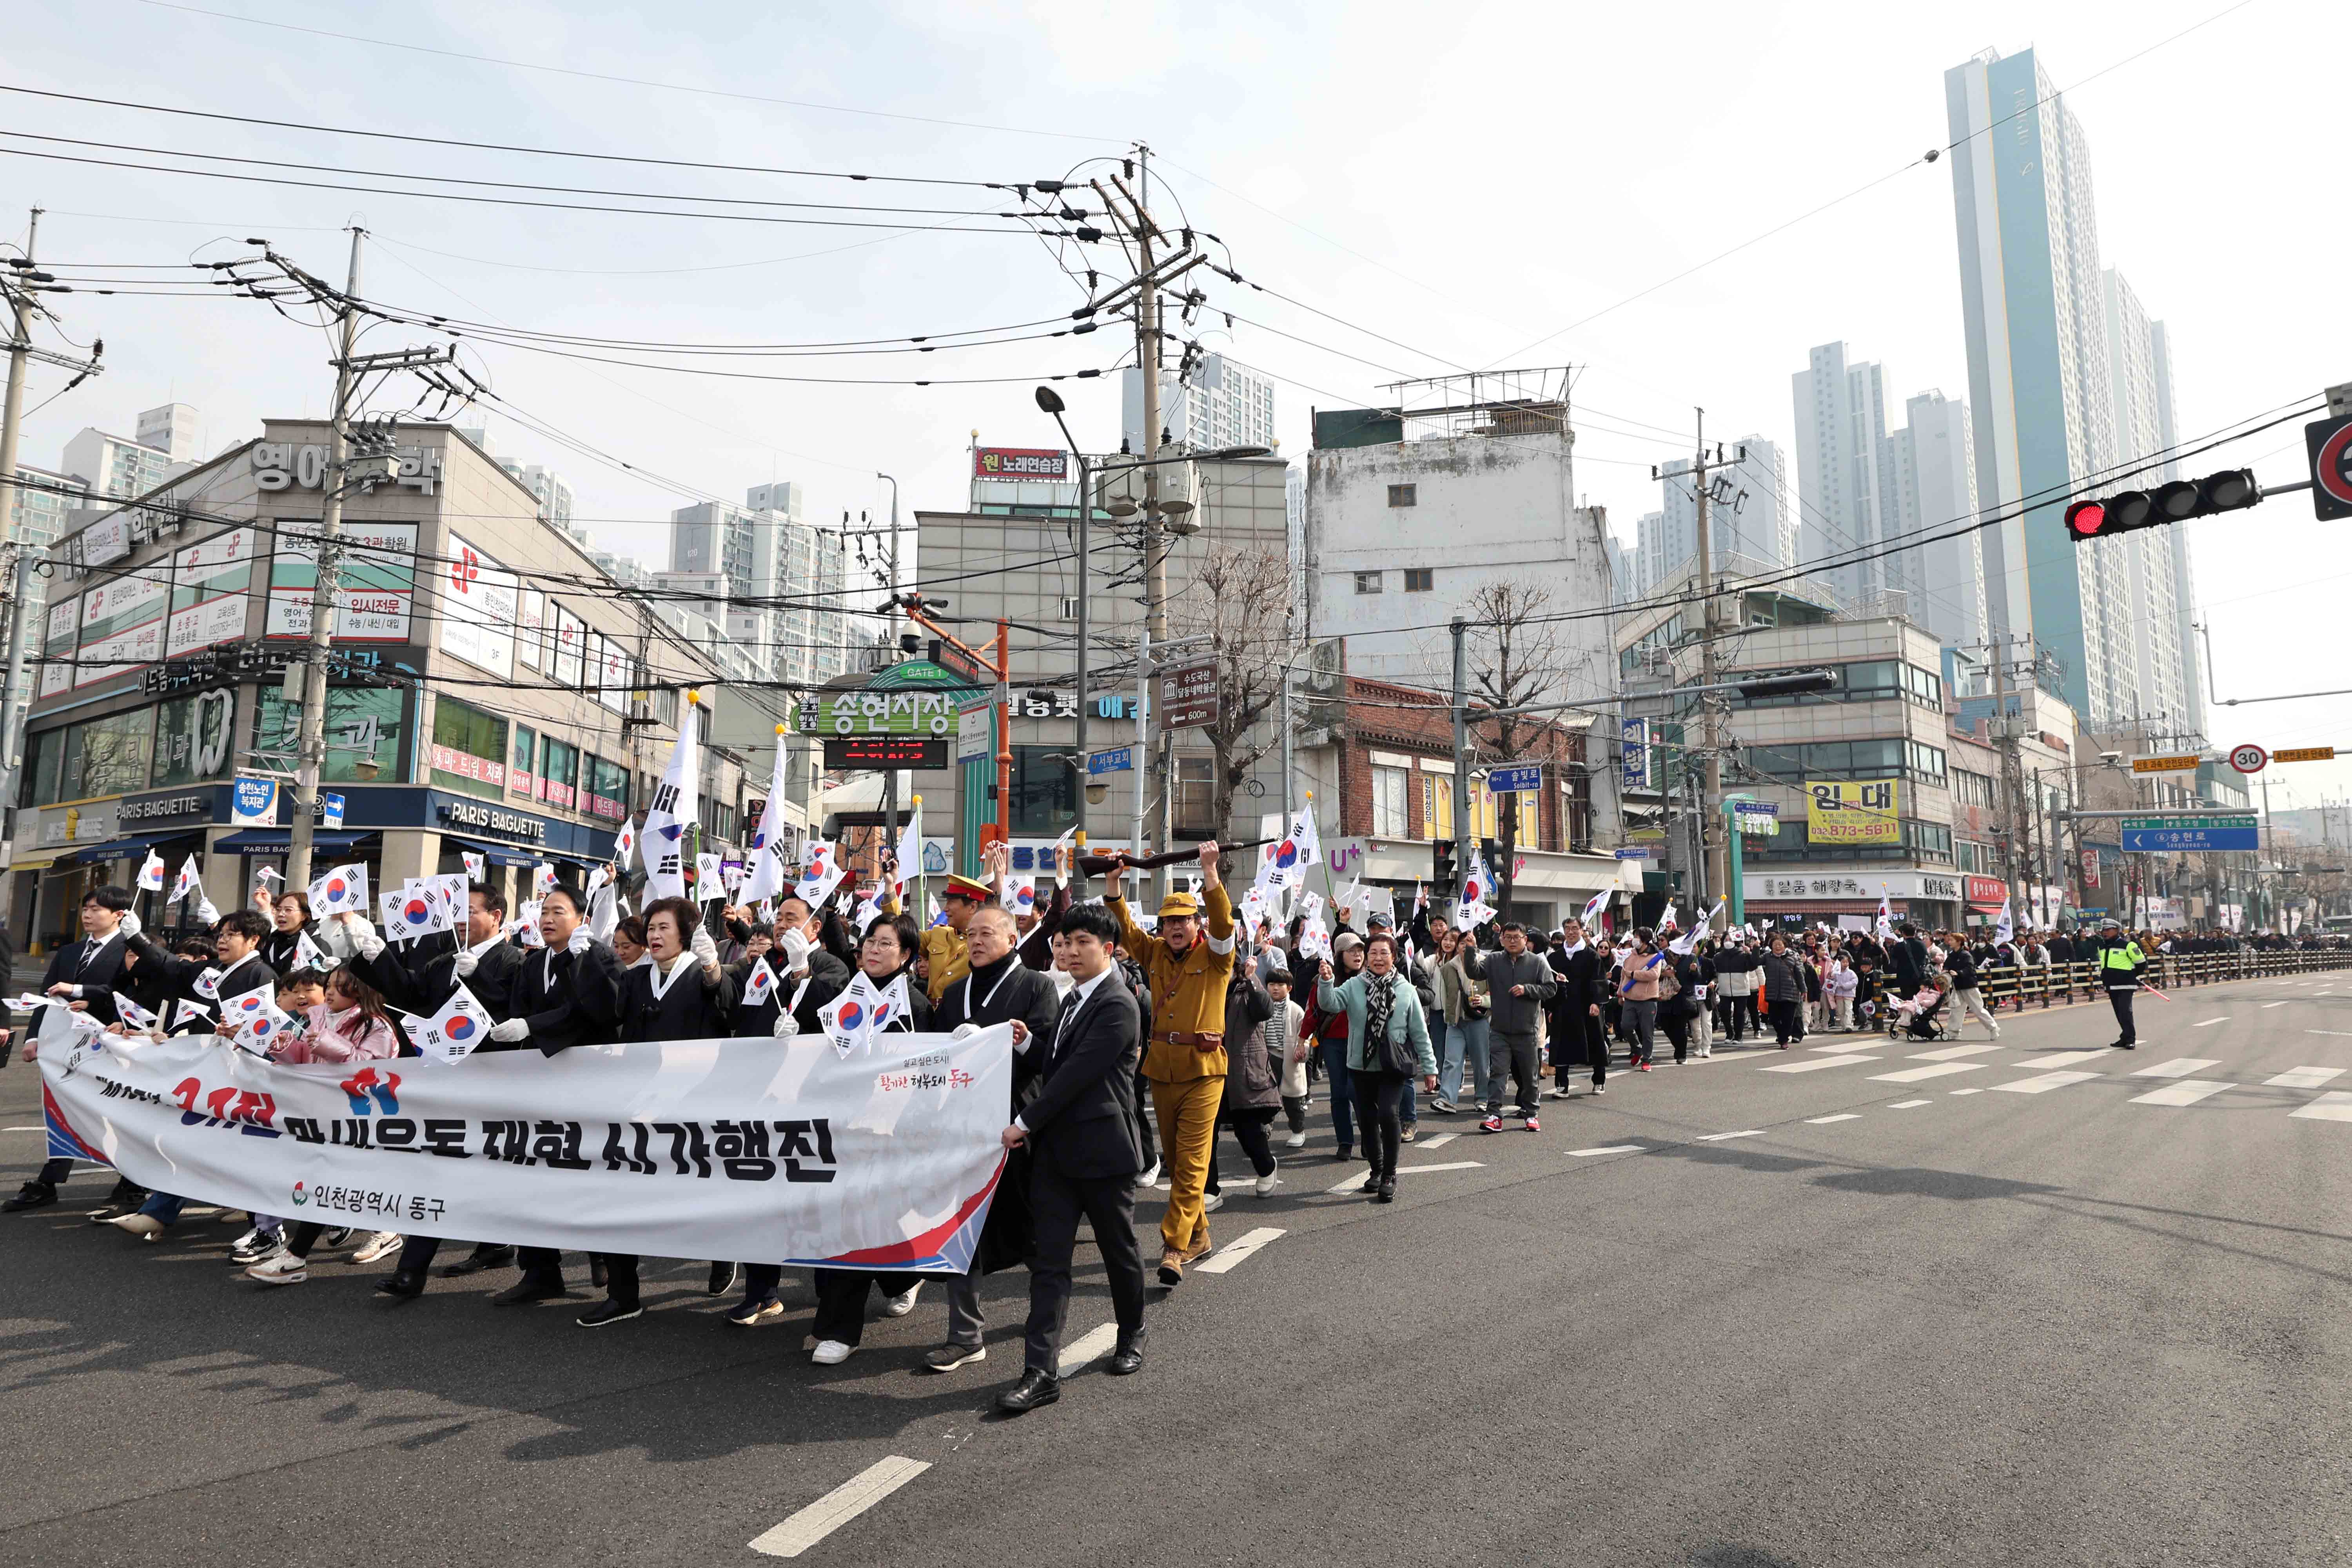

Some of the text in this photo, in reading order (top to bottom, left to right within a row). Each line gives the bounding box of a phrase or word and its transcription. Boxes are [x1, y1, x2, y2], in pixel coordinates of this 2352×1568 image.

[982, 454, 1064, 474] 원 노래연습장
[291, 597, 314, 606] 초중
[351, 599, 399, 614] 입시전문
[485, 592, 514, 619] 동인천파머스
[217, 604, 237, 619] 교육상담
[348, 618, 361, 628] 수능
[368, 619, 380, 628] 내신
[387, 618, 399, 629] 대입
[491, 649, 499, 660] 3F
[907, 668, 934, 677] GATE
[1184, 670, 1210, 684] 수도국산
[1178, 682, 1216, 698] 달동네박물관
[831, 693, 955, 734] 송현시장
[1188, 710, 1207, 720] 600m
[1624, 724, 1644, 772] 래방
[1099, 751, 1129, 767] 서부교회
[2136, 761, 2149, 770] 신호
[2151, 760, 2163, 769] 과속
[2238, 752, 2259, 765] 30
[486, 762, 503, 784] 치과
[1511, 769, 1538, 781] 솔빛로
[1625, 776, 1644, 784] 2F
[513, 774, 529, 788] 상담문의
[238, 782, 269, 796] 송현노인
[116, 796, 201, 820] PARIS BAGUETTE
[241, 796, 265, 808] 복지관
[452, 802, 546, 838] PARIS BAGUETTE
[2170, 832, 2206, 842] 송현로
[1331, 843, 1362, 871] U+
[1779, 880, 1805, 895] 일품
[1812, 879, 1857, 893] 해장국
[918, 1057, 931, 1066] 싶은
[934, 1055, 949, 1065] 도시!
[881, 1069, 974, 1091] 활기찬 행복도시 동구
[481, 1120, 592, 1171] 재현
[604, 1118, 837, 1183] 시가행진
[314, 1185, 446, 1221] 인천광역시 동구
